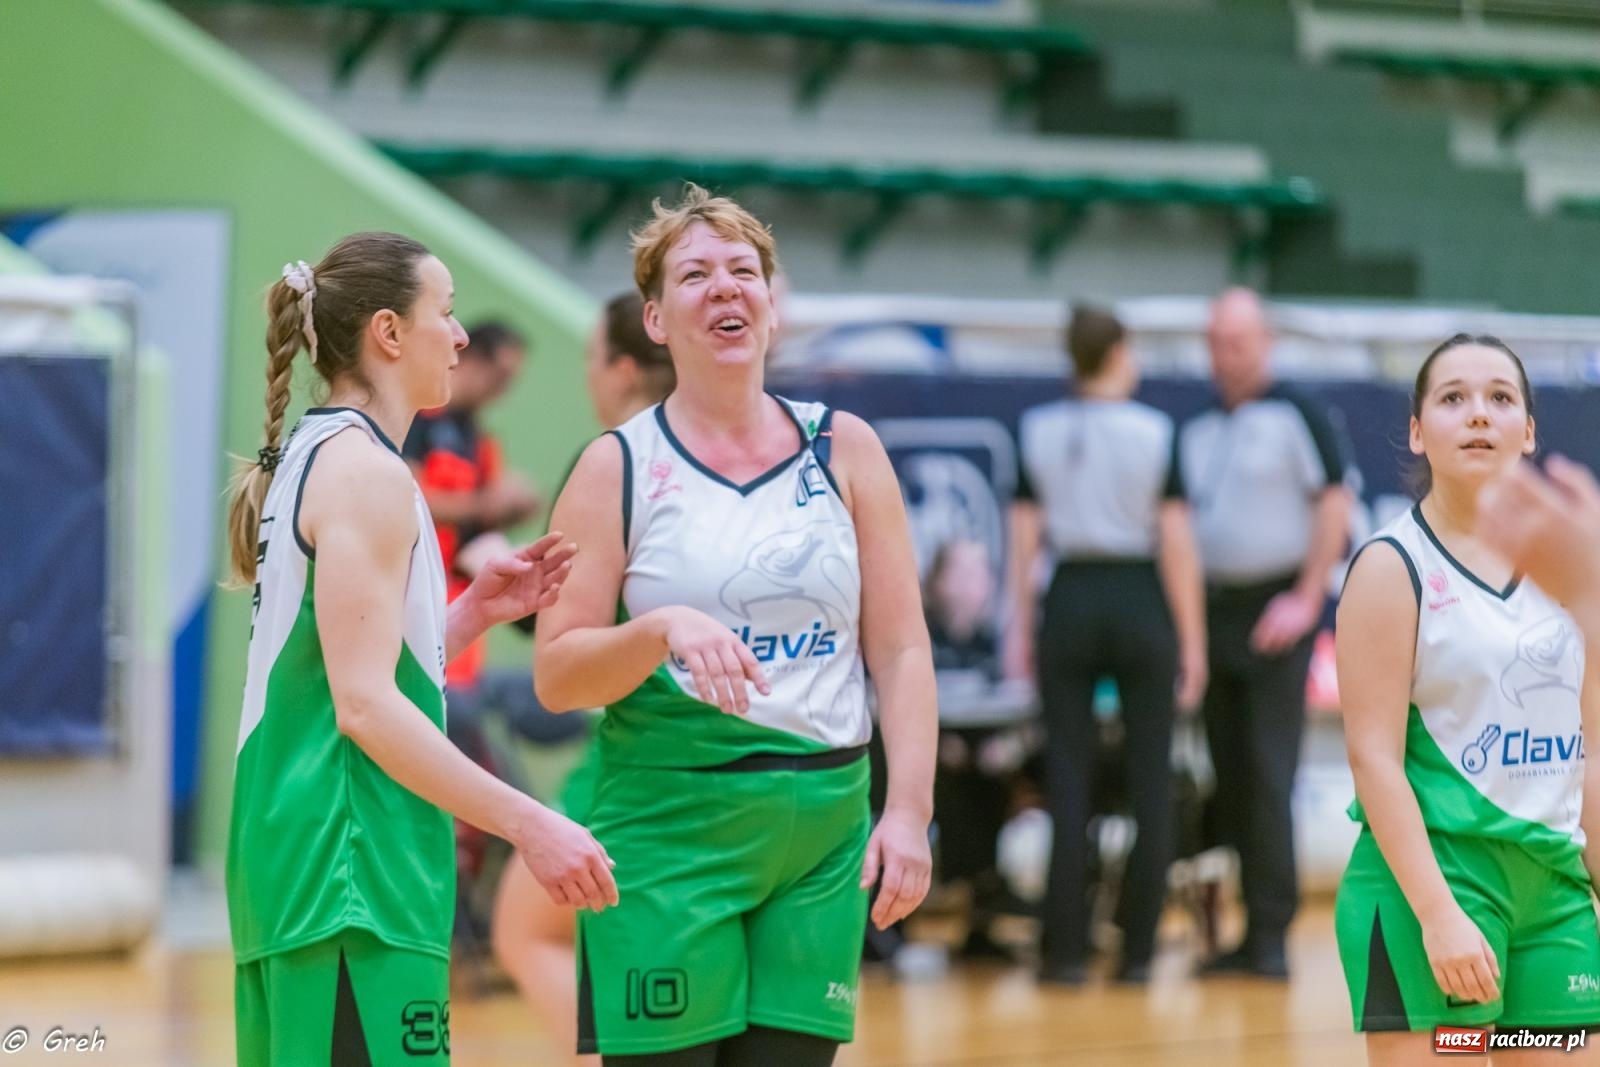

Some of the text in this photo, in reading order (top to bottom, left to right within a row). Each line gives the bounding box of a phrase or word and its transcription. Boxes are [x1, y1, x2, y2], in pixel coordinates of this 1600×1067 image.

[731, 621, 837, 663] avis
[1502, 727, 1585, 766] Clavi
[626, 967, 689, 1020] 10
[401, 1000, 450, 1056] 3
